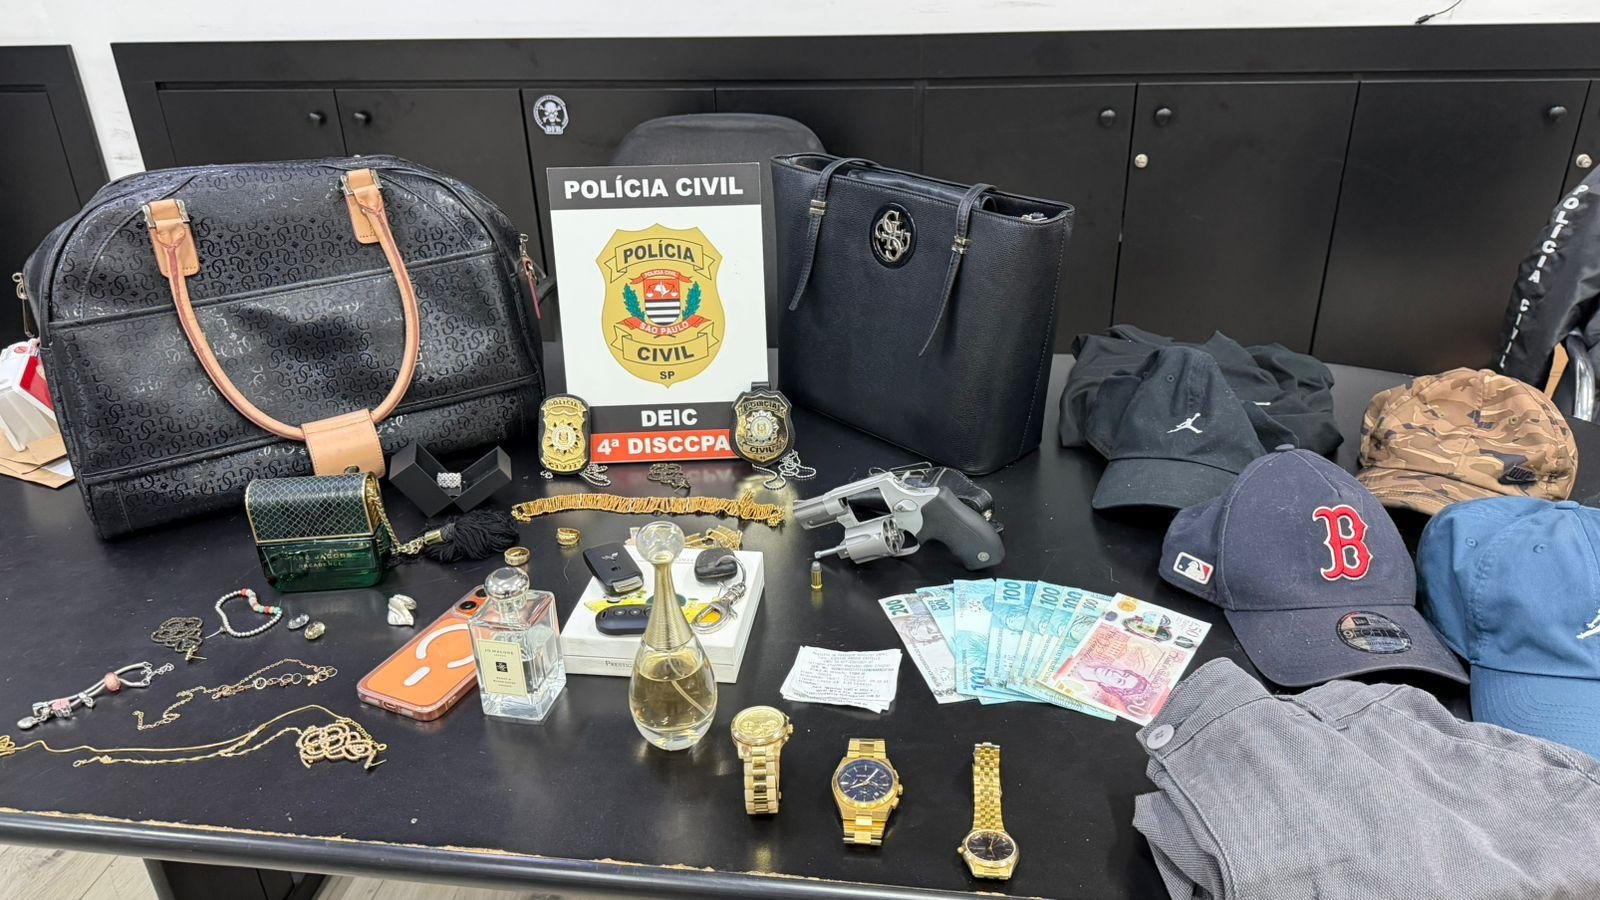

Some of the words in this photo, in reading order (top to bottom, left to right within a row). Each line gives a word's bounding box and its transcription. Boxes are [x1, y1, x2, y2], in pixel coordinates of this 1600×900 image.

[564, 175, 669, 199] POLÍCIA
[675, 176, 744, 197] CIVIL
[623, 240, 695, 264] POLÍCIA
[660, 321, 689, 334] PAULO
[637, 346, 695, 362] CIVIL
[659, 370, 675, 380] SP
[641, 408, 698, 427] DEIC
[628, 435, 731, 454] DISCCPA
[1312, 504, 1373, 581] B
[1003, 581, 1021, 601] 100
[1040, 586, 1061, 608] 100
[1062, 590, 1083, 609] 100
[885, 599, 909, 616] 200
